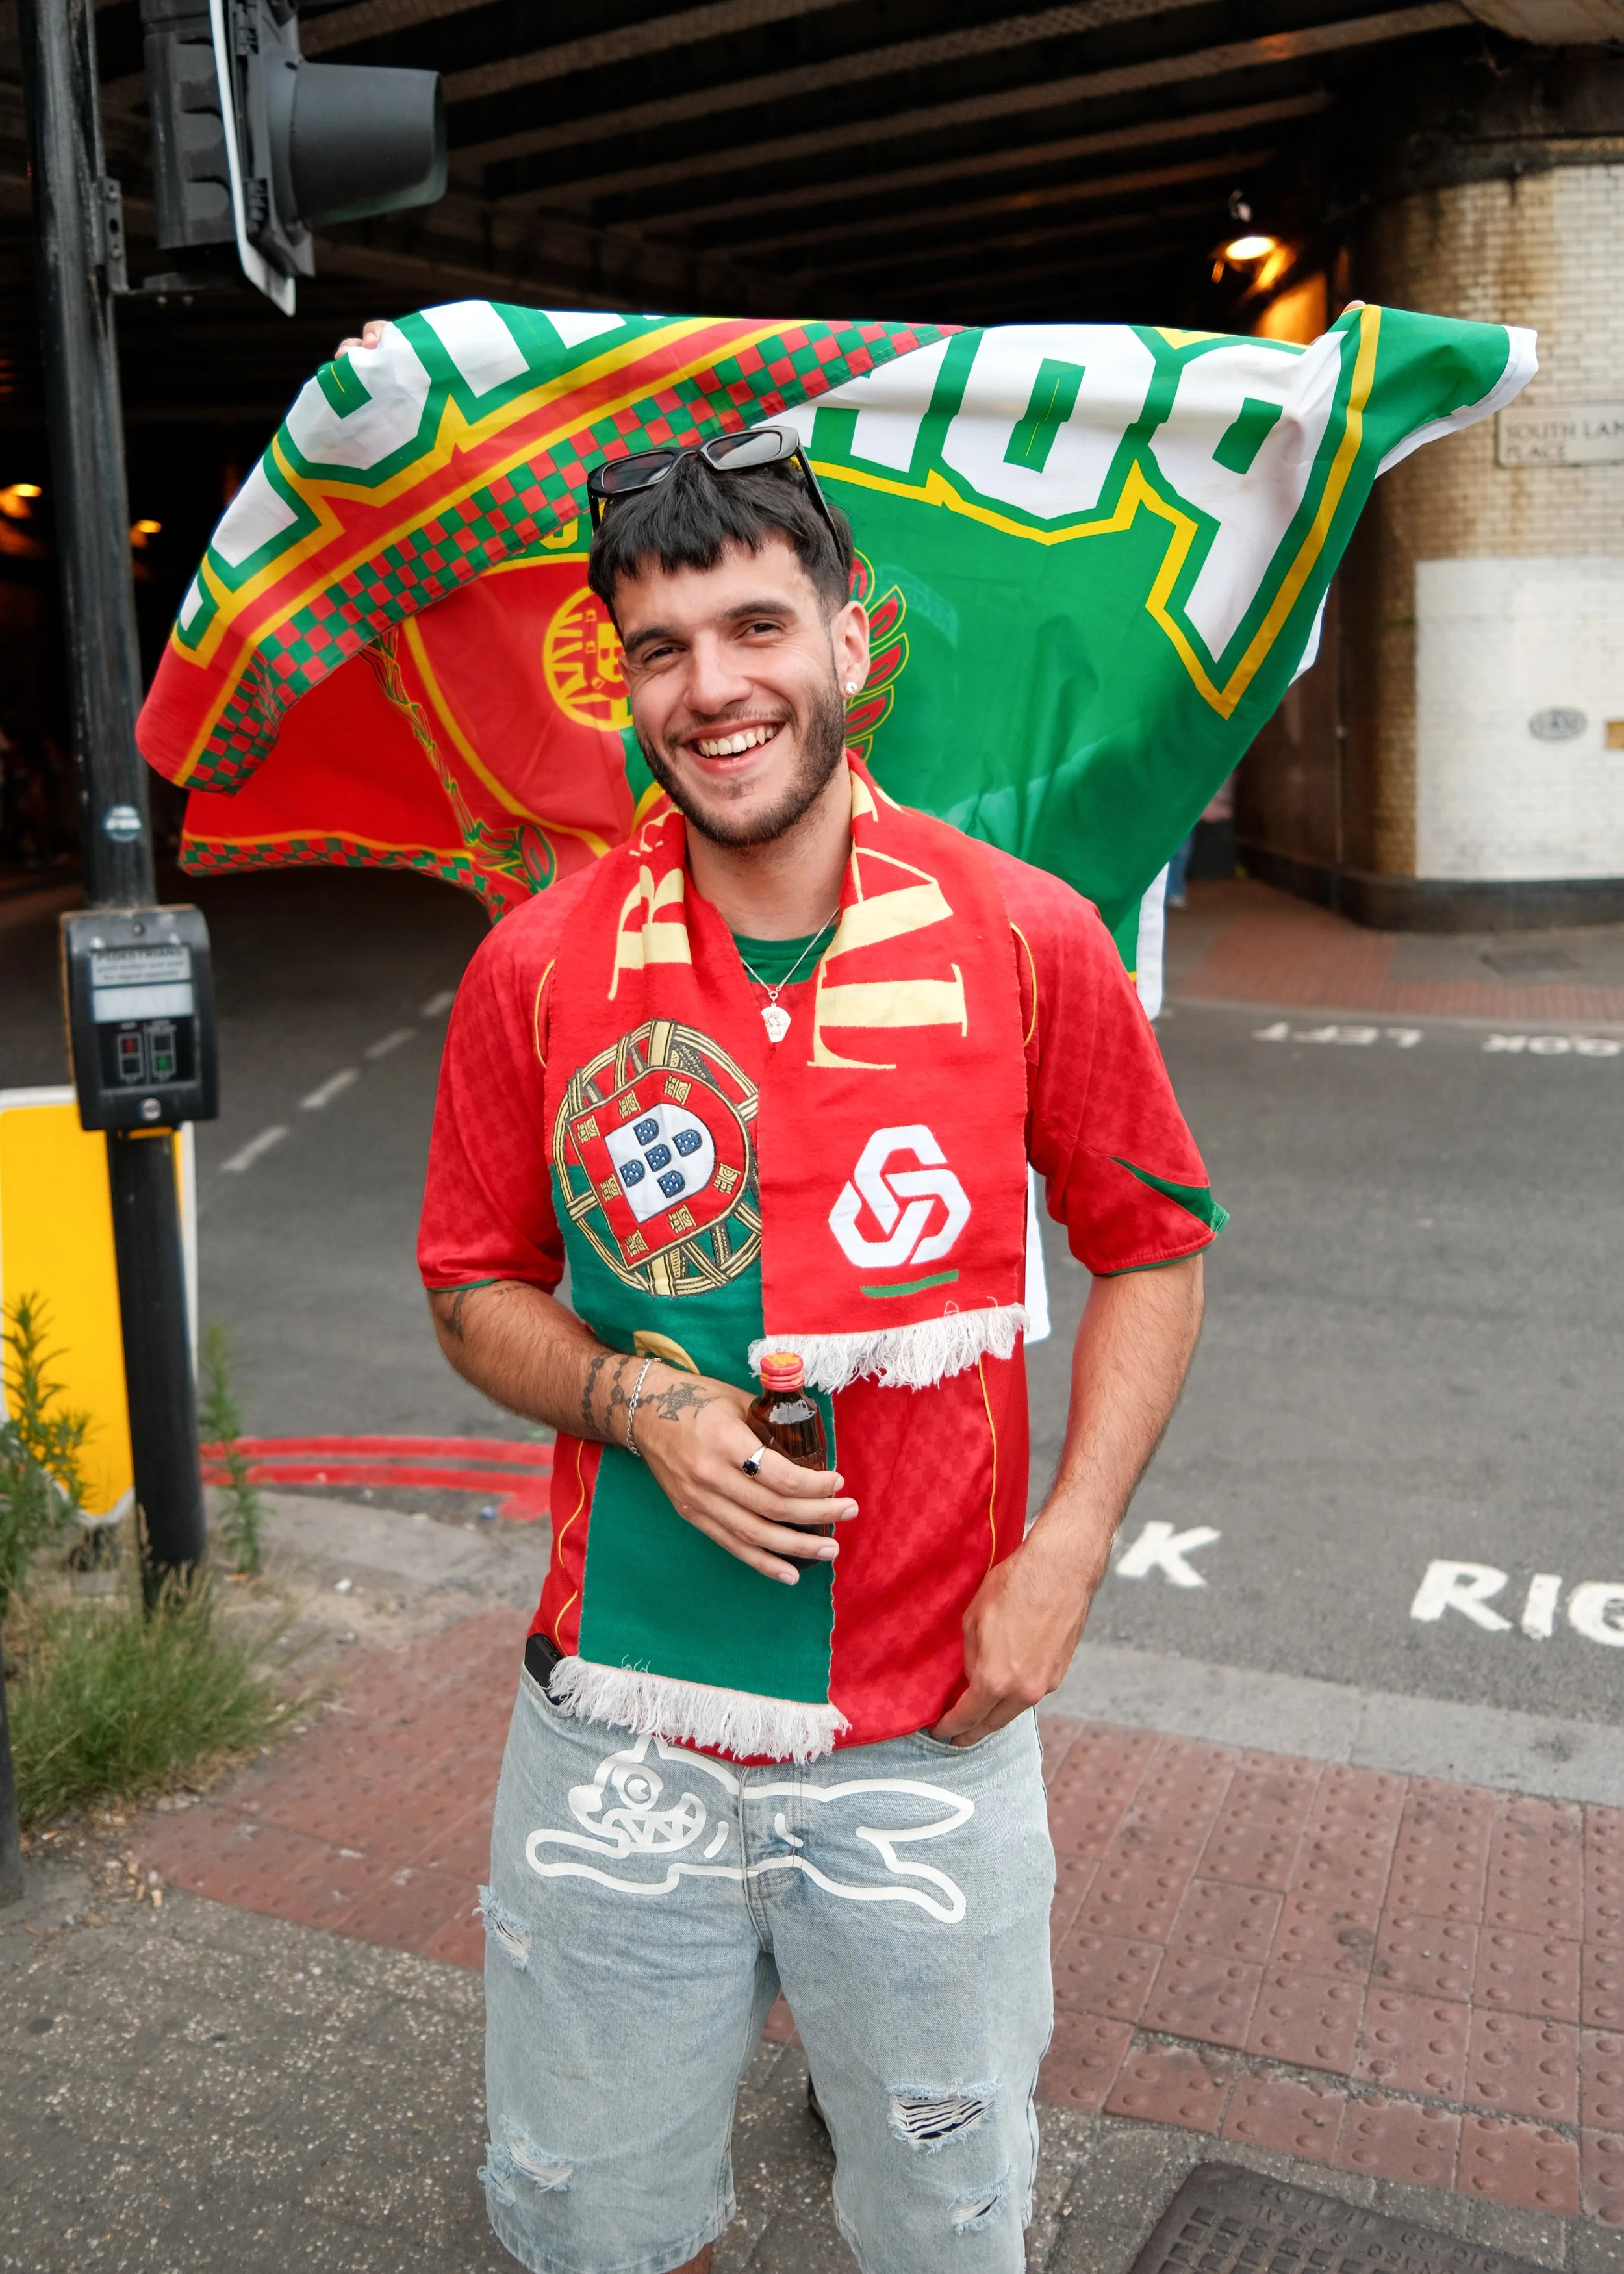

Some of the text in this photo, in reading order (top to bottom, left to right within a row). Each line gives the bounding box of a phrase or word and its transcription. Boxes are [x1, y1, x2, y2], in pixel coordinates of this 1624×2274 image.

[1506, 421, 1577, 439] SOUTH
[1506, 442, 1567, 459] PLACE
[1481, 1034, 1621, 1057] OOK
